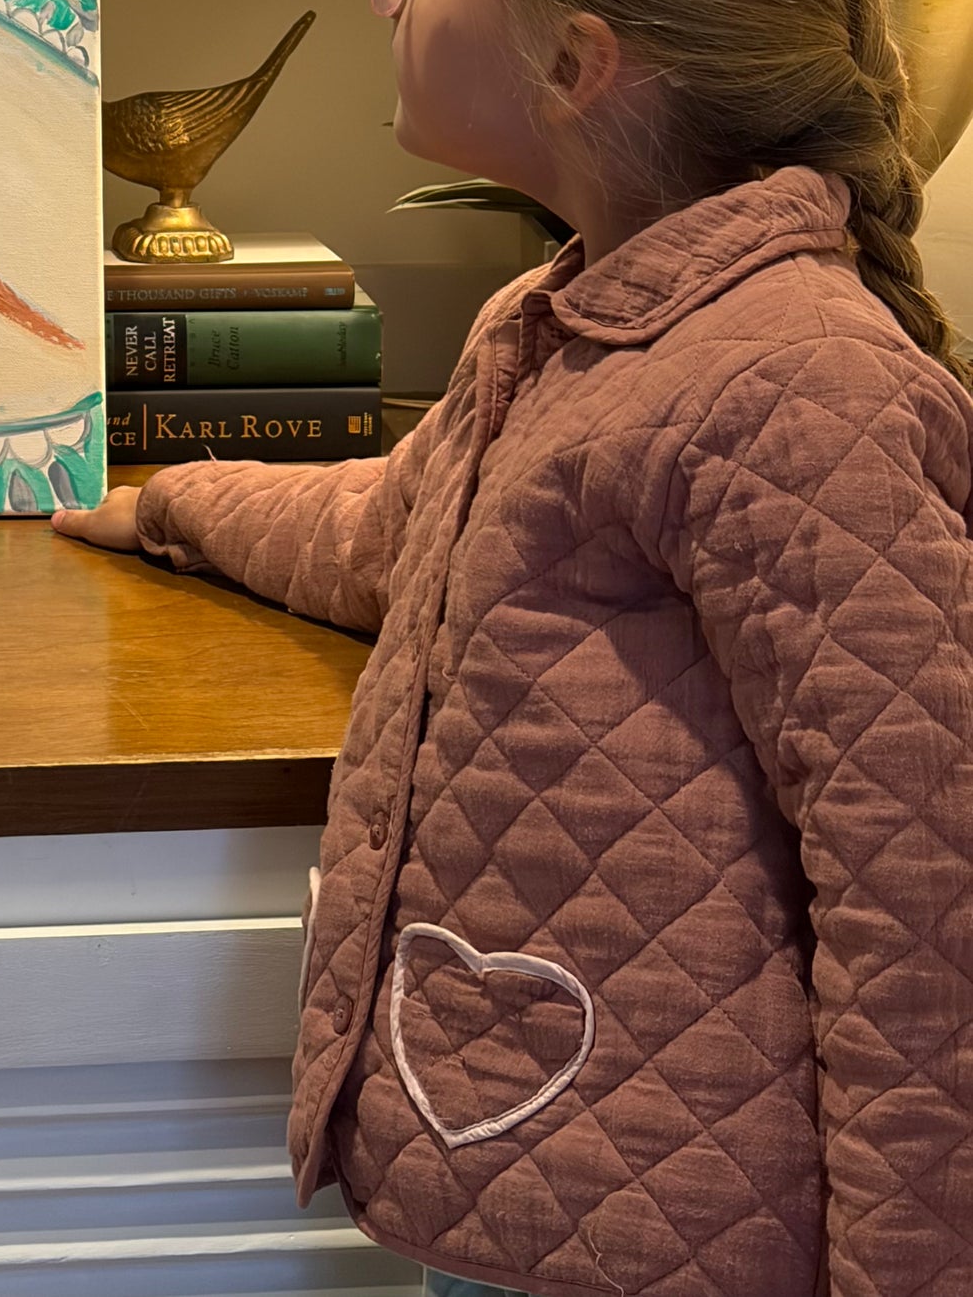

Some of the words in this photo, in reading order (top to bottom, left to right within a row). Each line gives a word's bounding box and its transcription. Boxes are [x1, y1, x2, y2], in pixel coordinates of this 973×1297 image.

[118, 287, 196, 302] THOUSAND
[199, 287, 237, 300] GIFTS
[125, 325, 138, 376] NEVER
[144, 331, 157, 371] CALL
[162, 317, 176, 383] RETREAT
[109, 431, 137, 447] CE
[155, 413, 232, 439] KARL
[240, 414, 322, 439] ROVE
